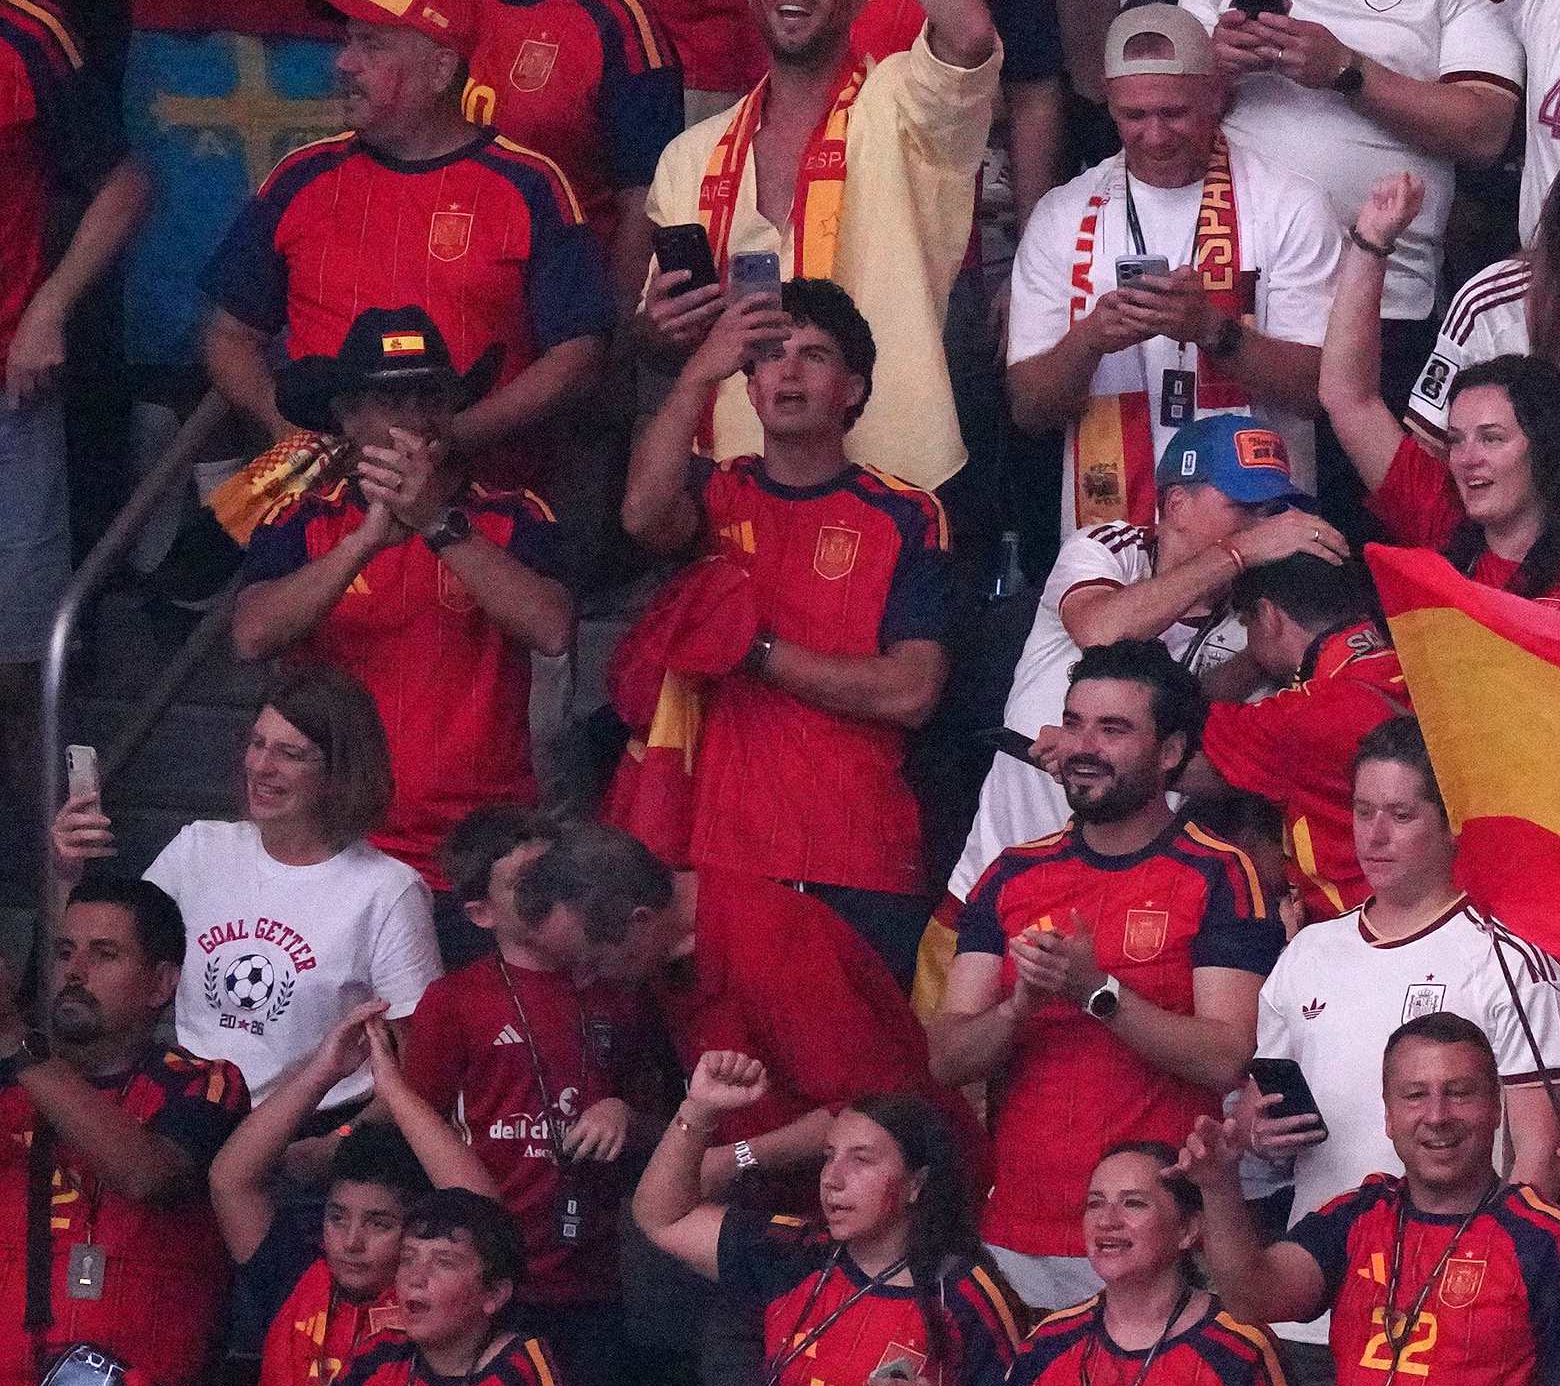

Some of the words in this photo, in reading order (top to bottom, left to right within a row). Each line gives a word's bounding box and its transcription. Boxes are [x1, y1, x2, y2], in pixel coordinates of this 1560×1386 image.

[198, 918, 250, 955] GOAL
[253, 916, 317, 974] GETTER
[218, 1013, 237, 1029] 20
[248, 1019, 265, 1036] 26
[489, 1120, 527, 1139] dell
[1359, 1307, 1438, 1377] 22
